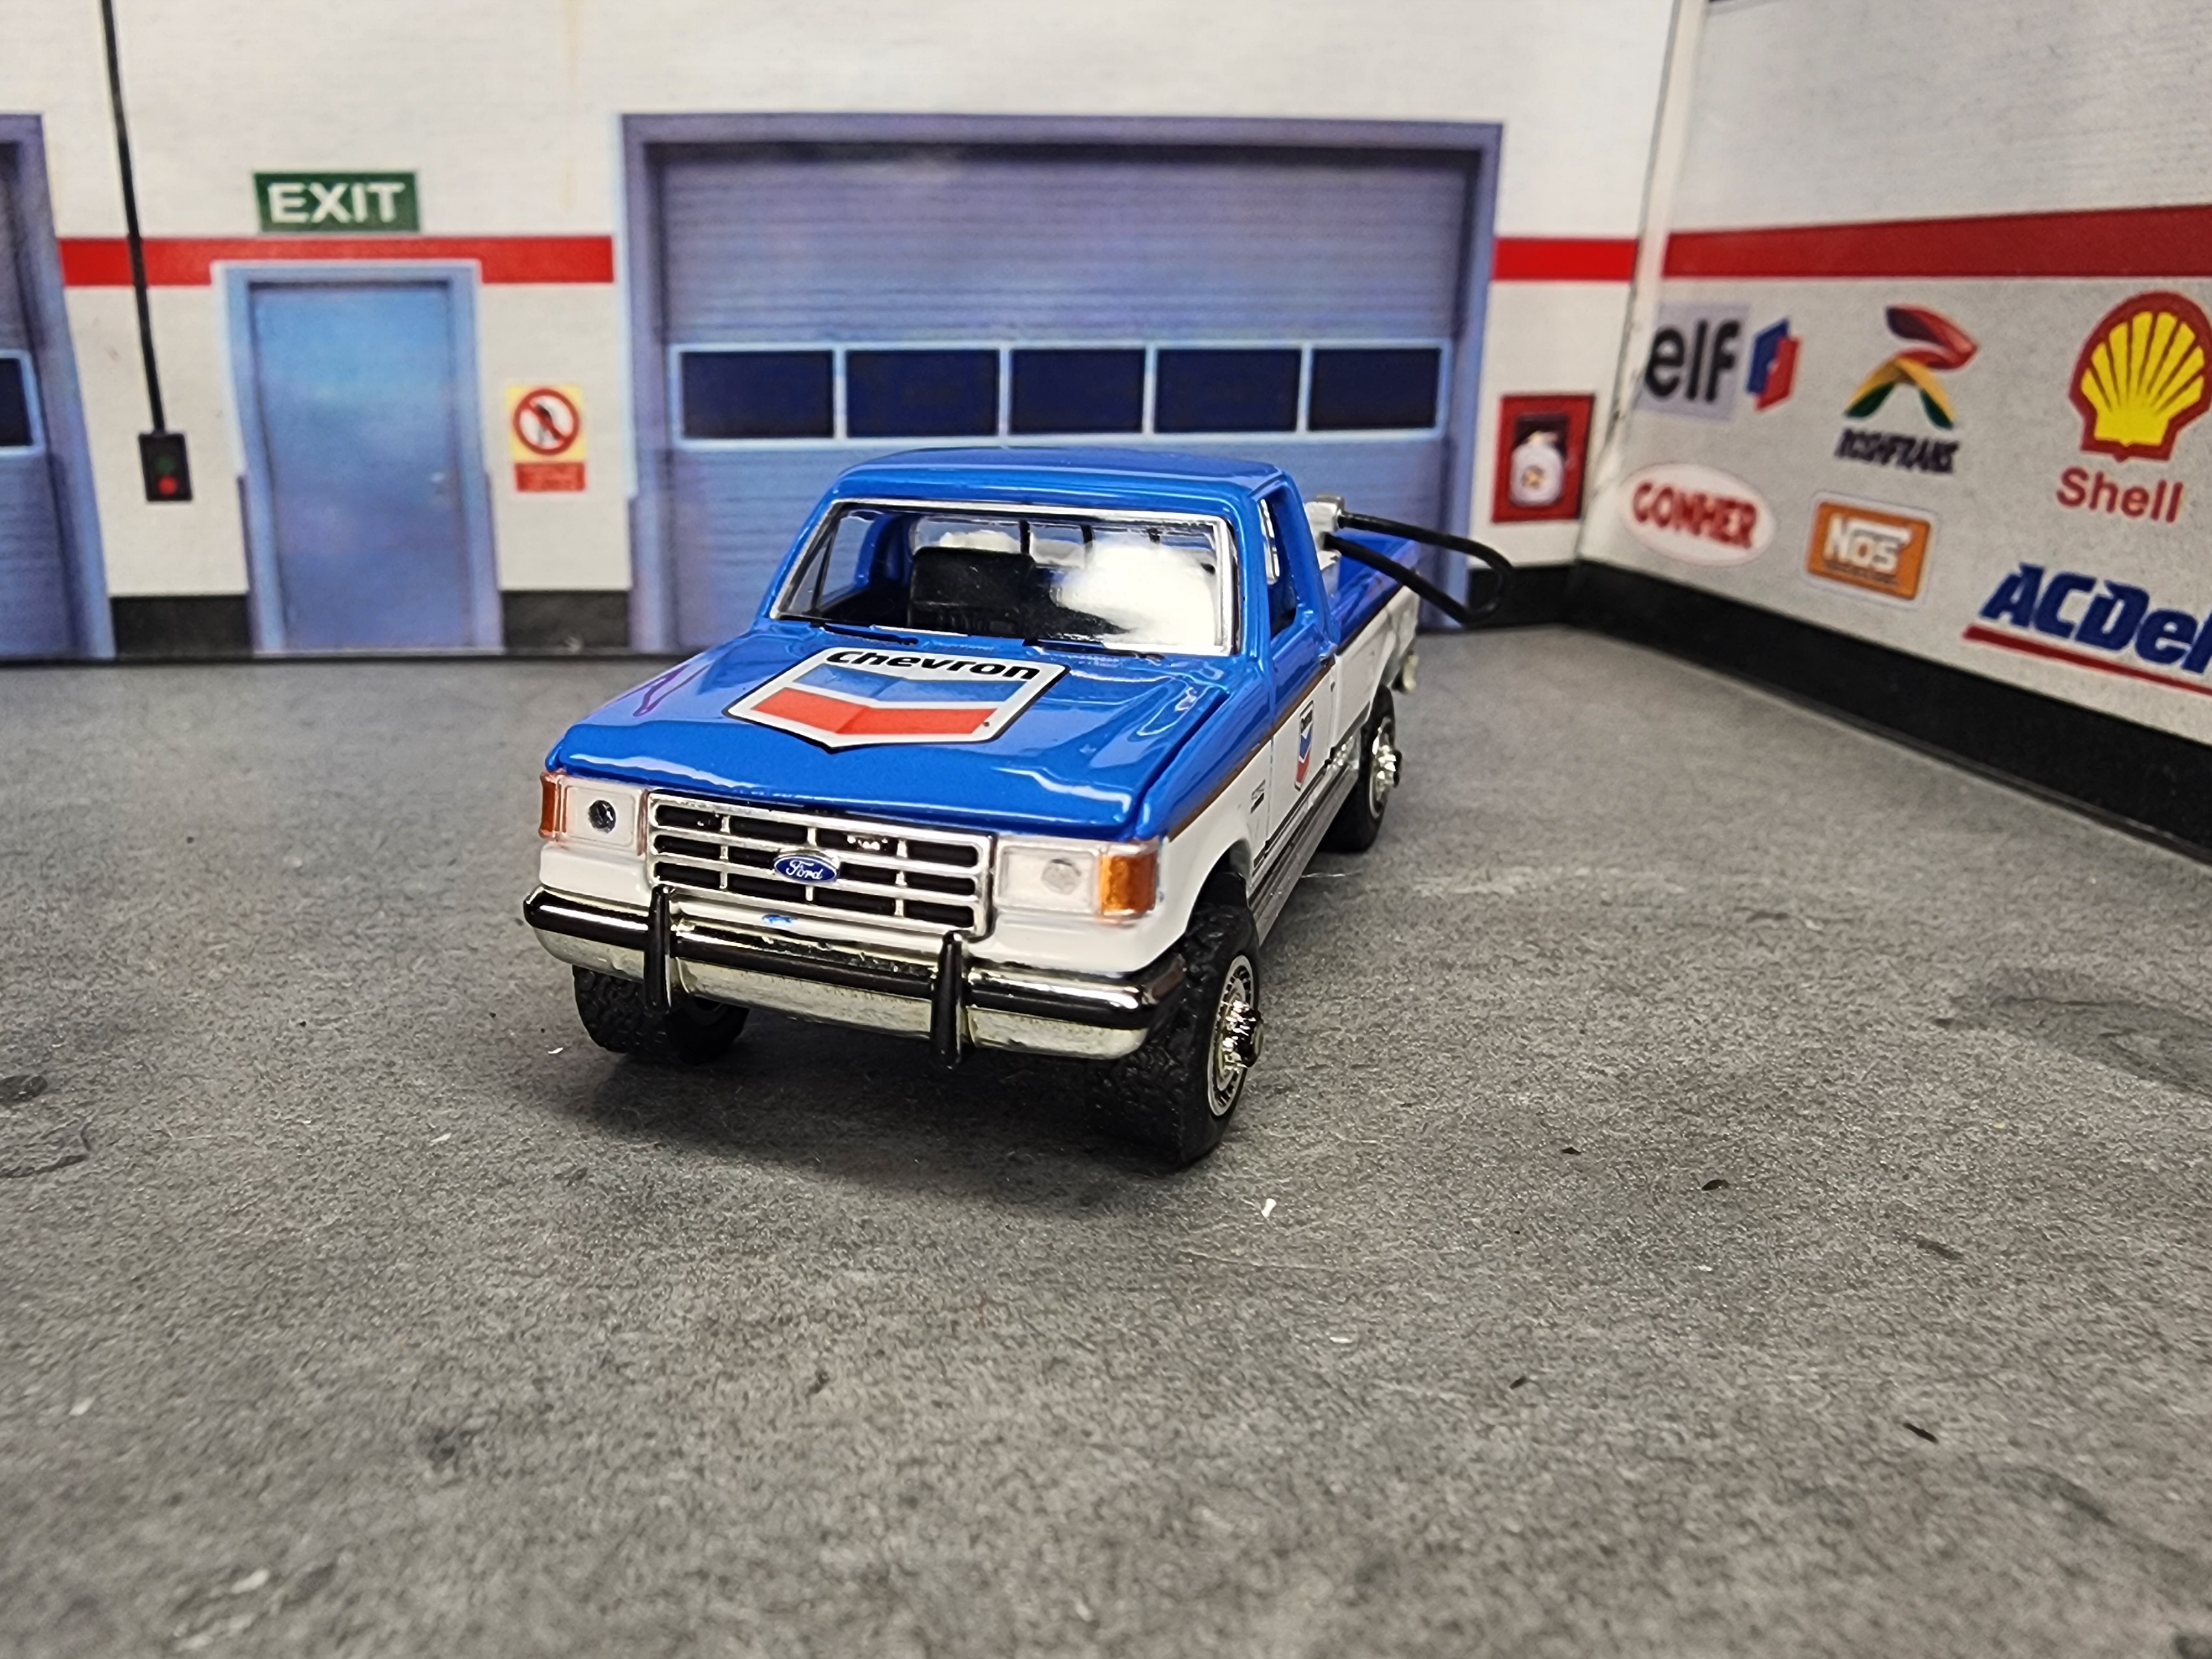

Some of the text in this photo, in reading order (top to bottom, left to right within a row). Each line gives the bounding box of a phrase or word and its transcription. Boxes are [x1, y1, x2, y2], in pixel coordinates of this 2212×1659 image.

[268, 181, 405, 223] EXIT
[1645, 319, 1741, 401] elf
[2056, 466, 2184, 523] Shell
[1823, 511, 1913, 573] NOS
[824, 650, 1041, 681] Chevron
[785, 859, 824, 880] Ford
